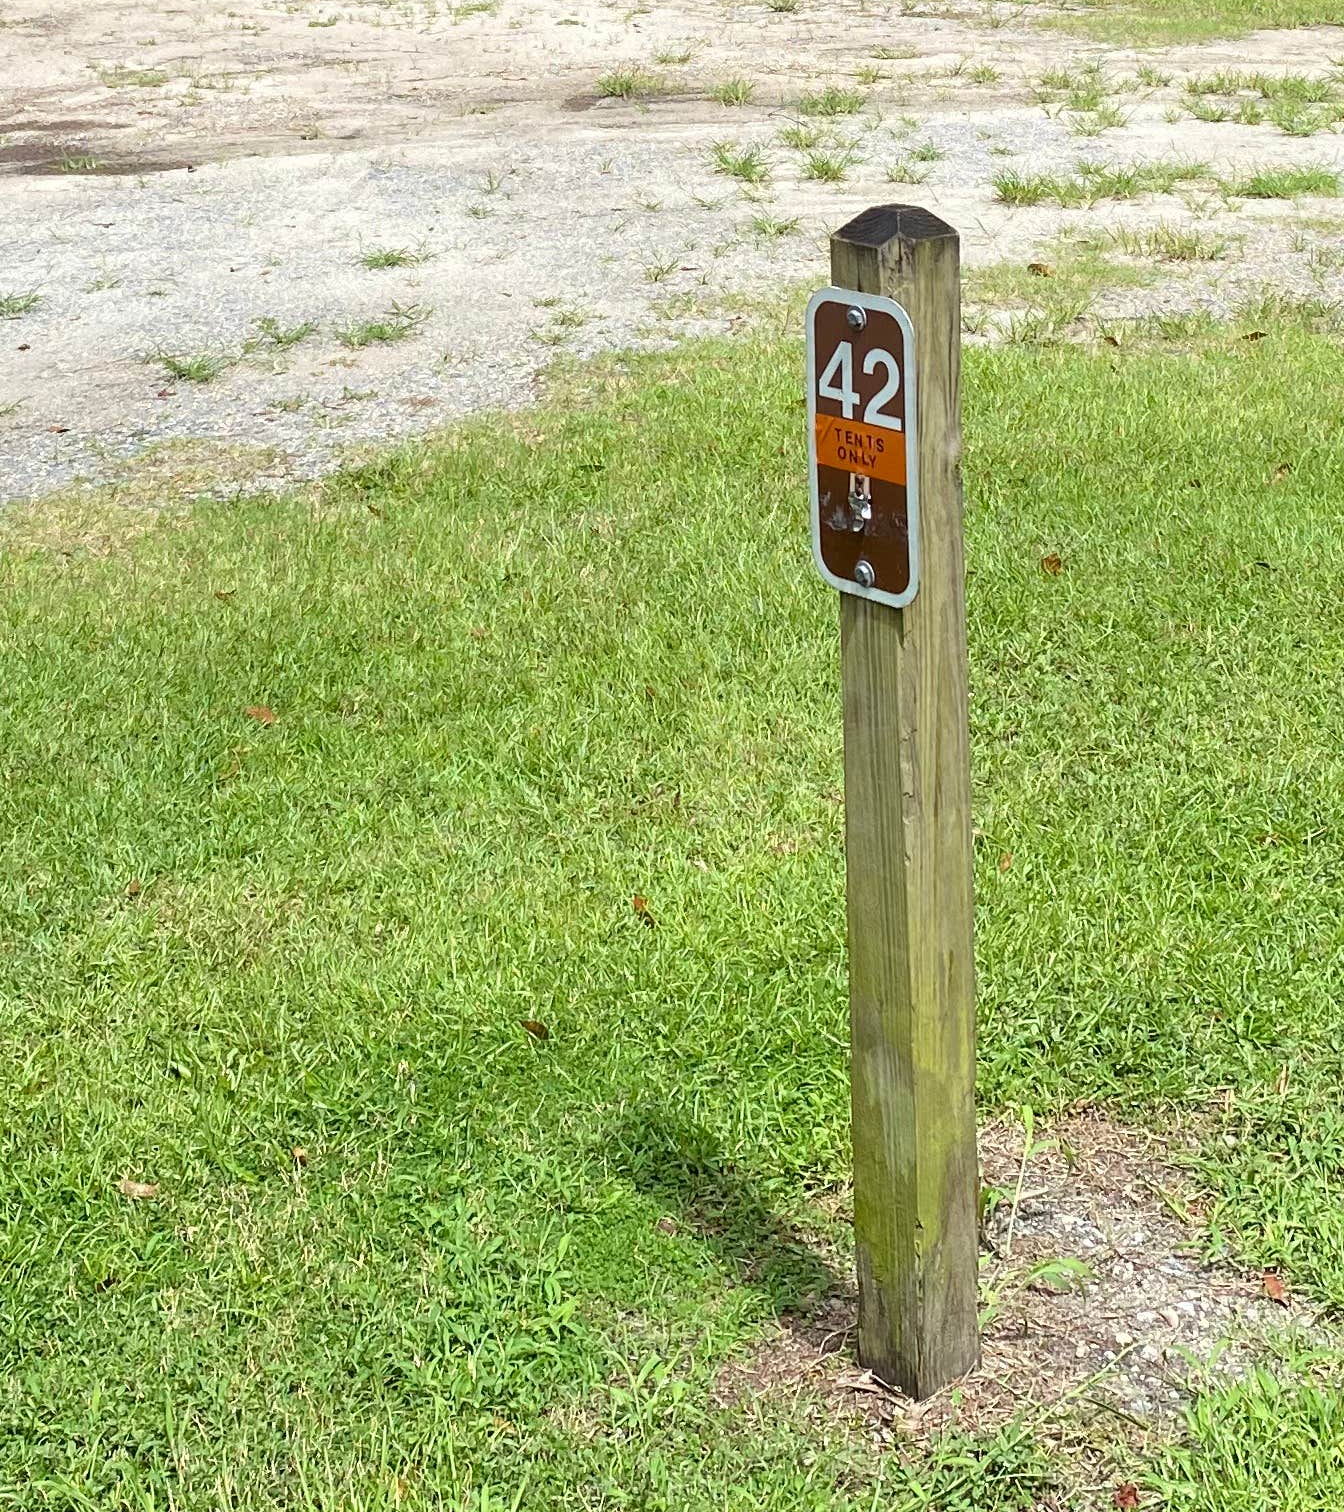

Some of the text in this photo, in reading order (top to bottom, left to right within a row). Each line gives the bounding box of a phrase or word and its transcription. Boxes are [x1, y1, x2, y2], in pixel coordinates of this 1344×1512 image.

[818, 340, 902, 431] 42
[834, 427, 885, 453] TENTS
[837, 445, 877, 468] ONLY
